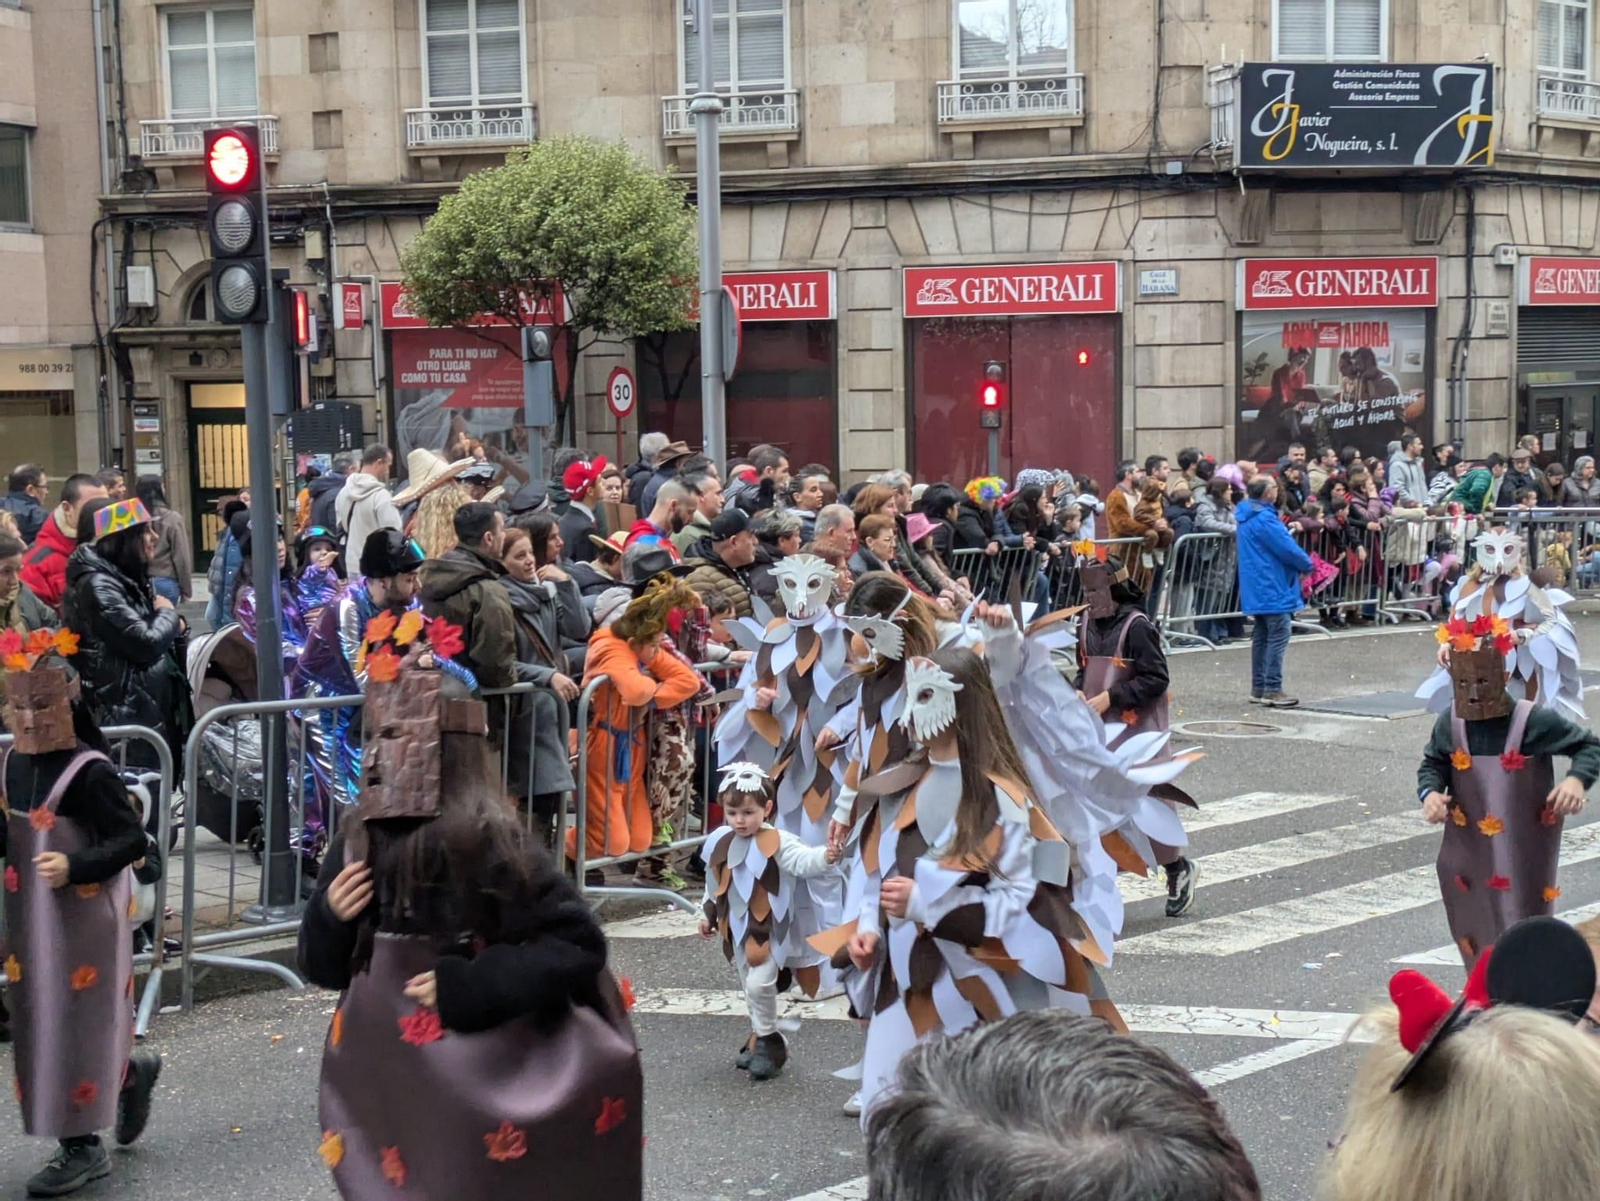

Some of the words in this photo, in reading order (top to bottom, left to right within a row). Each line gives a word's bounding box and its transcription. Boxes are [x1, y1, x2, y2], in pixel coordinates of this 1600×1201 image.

[1333, 69, 1393, 78] Administración
[1395, 69, 1420, 78] Fincas
[1332, 80, 1363, 89] Gestión
[1365, 80, 1420, 89] Comunidades
[1348, 92, 1383, 101] Asesoría
[1385, 92, 1420, 102] Empresa
[1262, 102, 1332, 161] Javier
[1304, 132, 1372, 157] Nogueira,
[960, 274, 1103, 304] GENERALI
[1295, 268, 1430, 297] GENERALI
[721, 282, 818, 310] NERALI
[1344, 321, 1389, 347] AHORA
[429, 348, 453, 359] PARA
[456, 348, 464, 359] TI
[466, 348, 478, 359] NO
[480, 348, 498, 359] HAY
[18, 363, 36, 373] 988
[38, 363, 49, 373] 00
[52, 363, 63, 373] 39
[416, 360, 440, 371] OTRO
[441, 360, 471, 371] LUGAR
[401, 372, 428, 383] COMO
[430, 372, 441, 383] TU
[443, 372, 467, 383] CASA
[614, 384, 630, 401] 30
[1307, 408, 1318, 418] EL
[1357, 401, 1368, 412] SE
[1357, 414, 1365, 426] Y
[1367, 410, 1397, 424] AHORA
